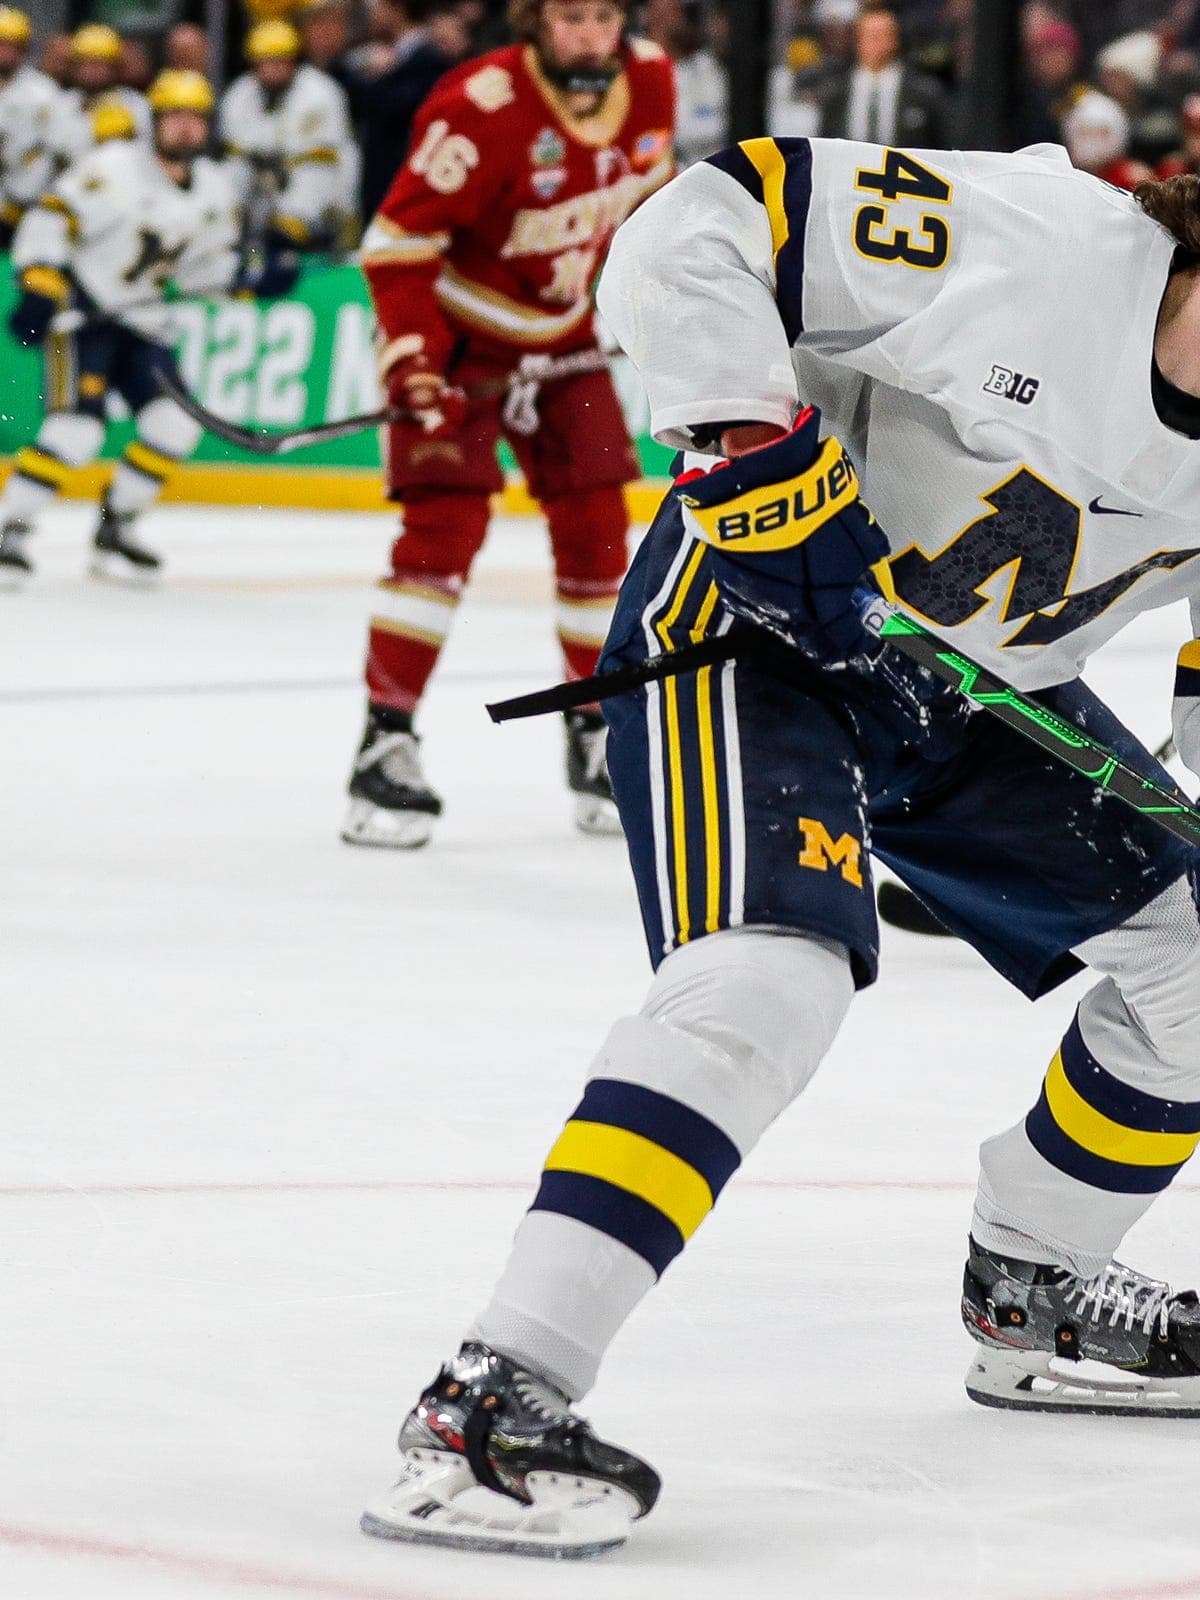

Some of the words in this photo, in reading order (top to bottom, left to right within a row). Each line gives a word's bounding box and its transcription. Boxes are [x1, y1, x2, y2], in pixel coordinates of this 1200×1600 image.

[409, 118, 479, 194] 16
[852, 146, 953, 271] 43
[798, 816, 864, 890] M
